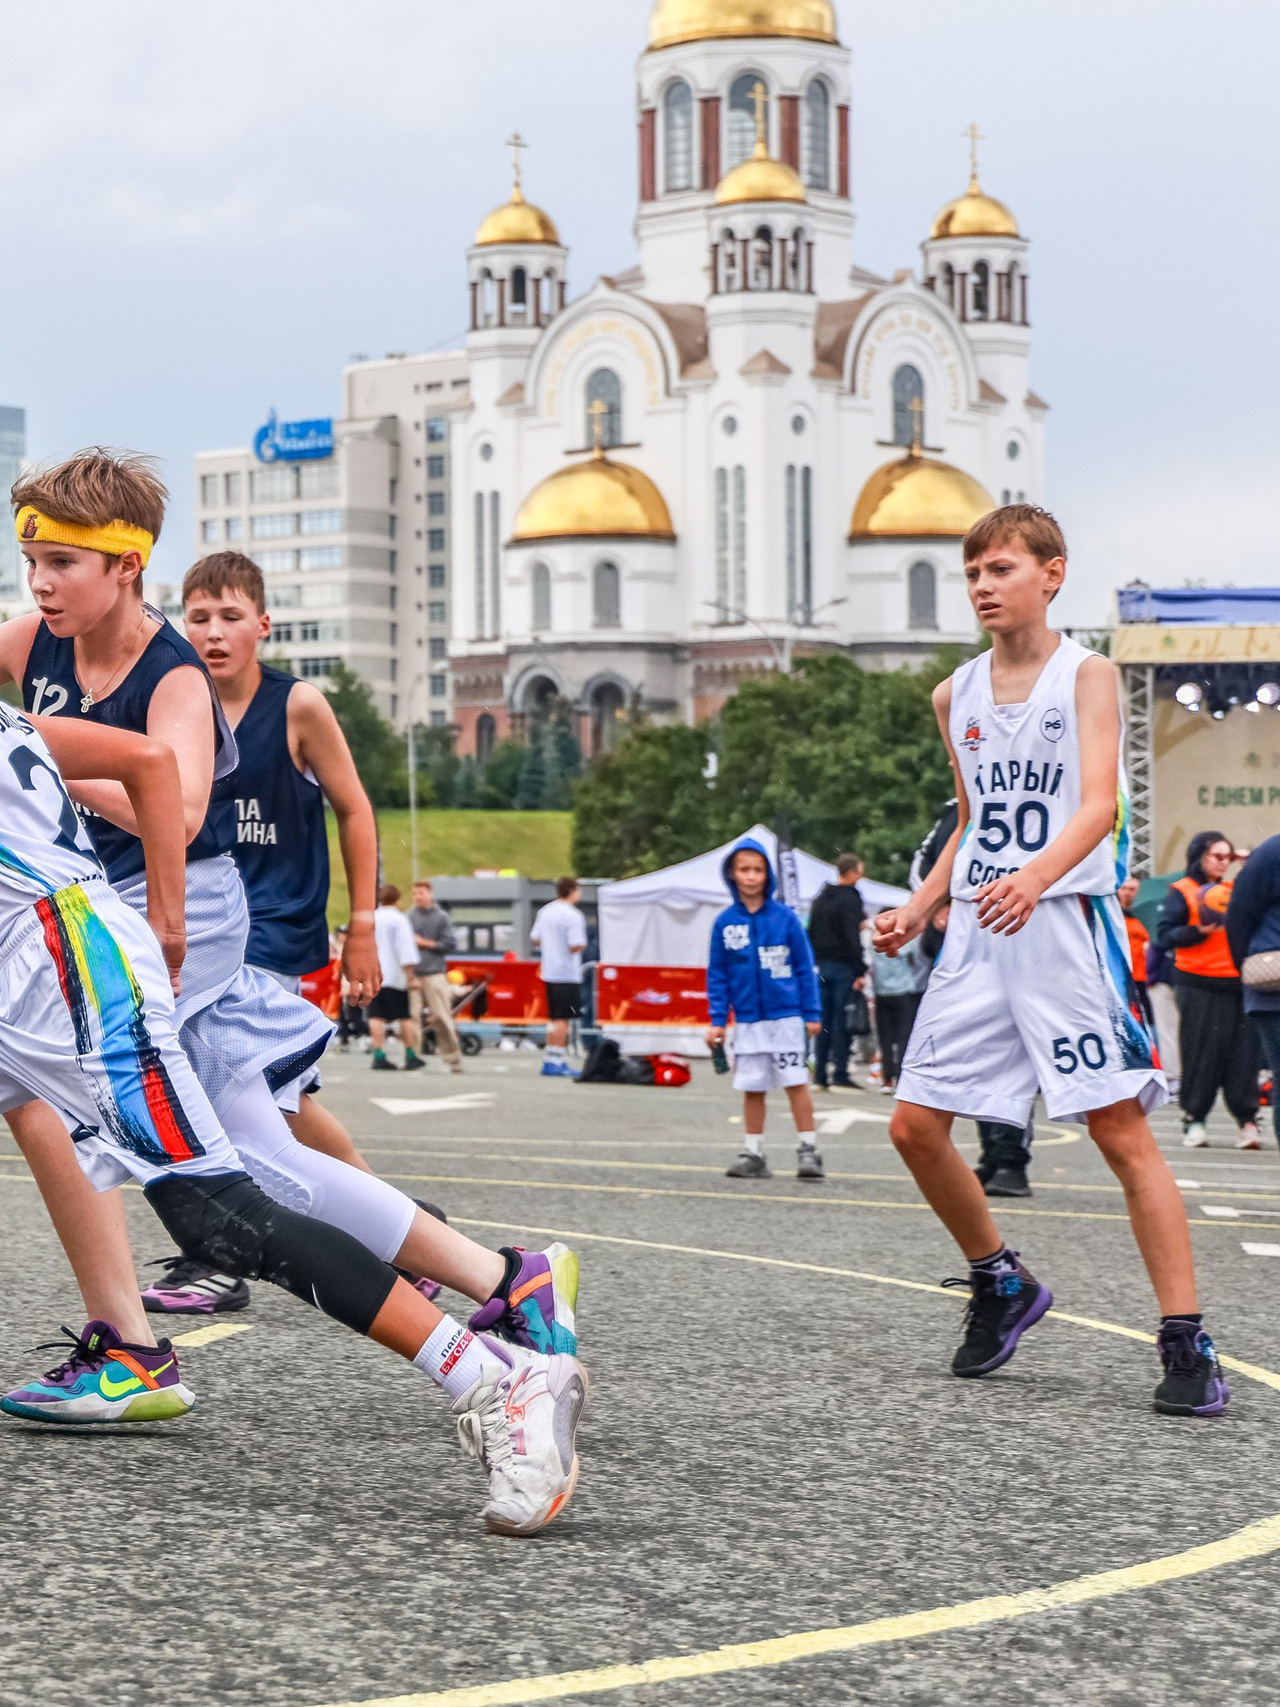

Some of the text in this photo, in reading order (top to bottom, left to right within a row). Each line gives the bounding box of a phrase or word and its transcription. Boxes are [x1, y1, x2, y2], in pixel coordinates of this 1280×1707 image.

[32, 676, 68, 716] 12
[978, 801, 1049, 852] 50
[778, 1052, 799, 1070] 52
[1052, 1032, 1107, 1075] 50
